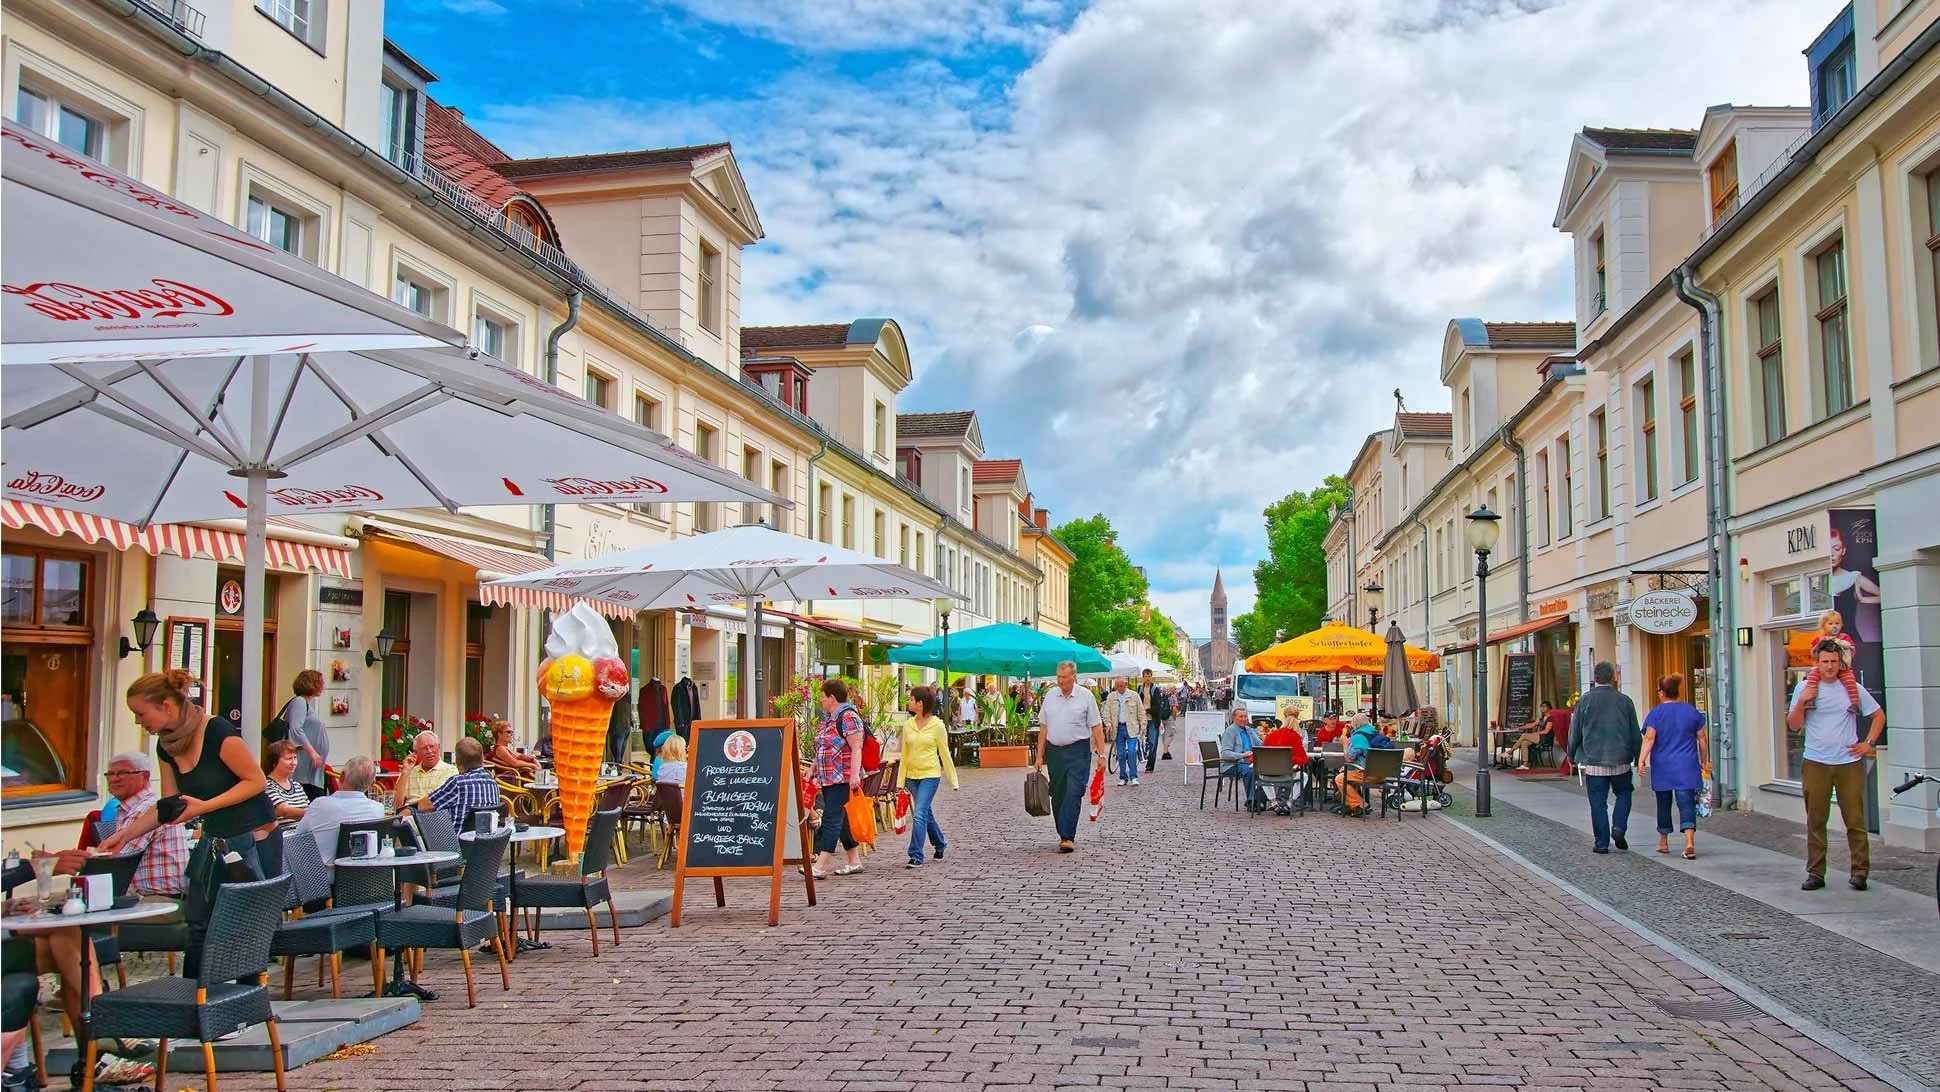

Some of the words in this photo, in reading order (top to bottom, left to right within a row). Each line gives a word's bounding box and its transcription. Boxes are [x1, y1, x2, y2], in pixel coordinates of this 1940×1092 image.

[1786, 523, 1817, 554] KPM
[1644, 597, 1681, 605] BÄCKEREI
[1635, 606, 1691, 618] steinecke
[701, 765, 760, 777] PROBIEREN
[713, 844, 744, 856] TORTE
